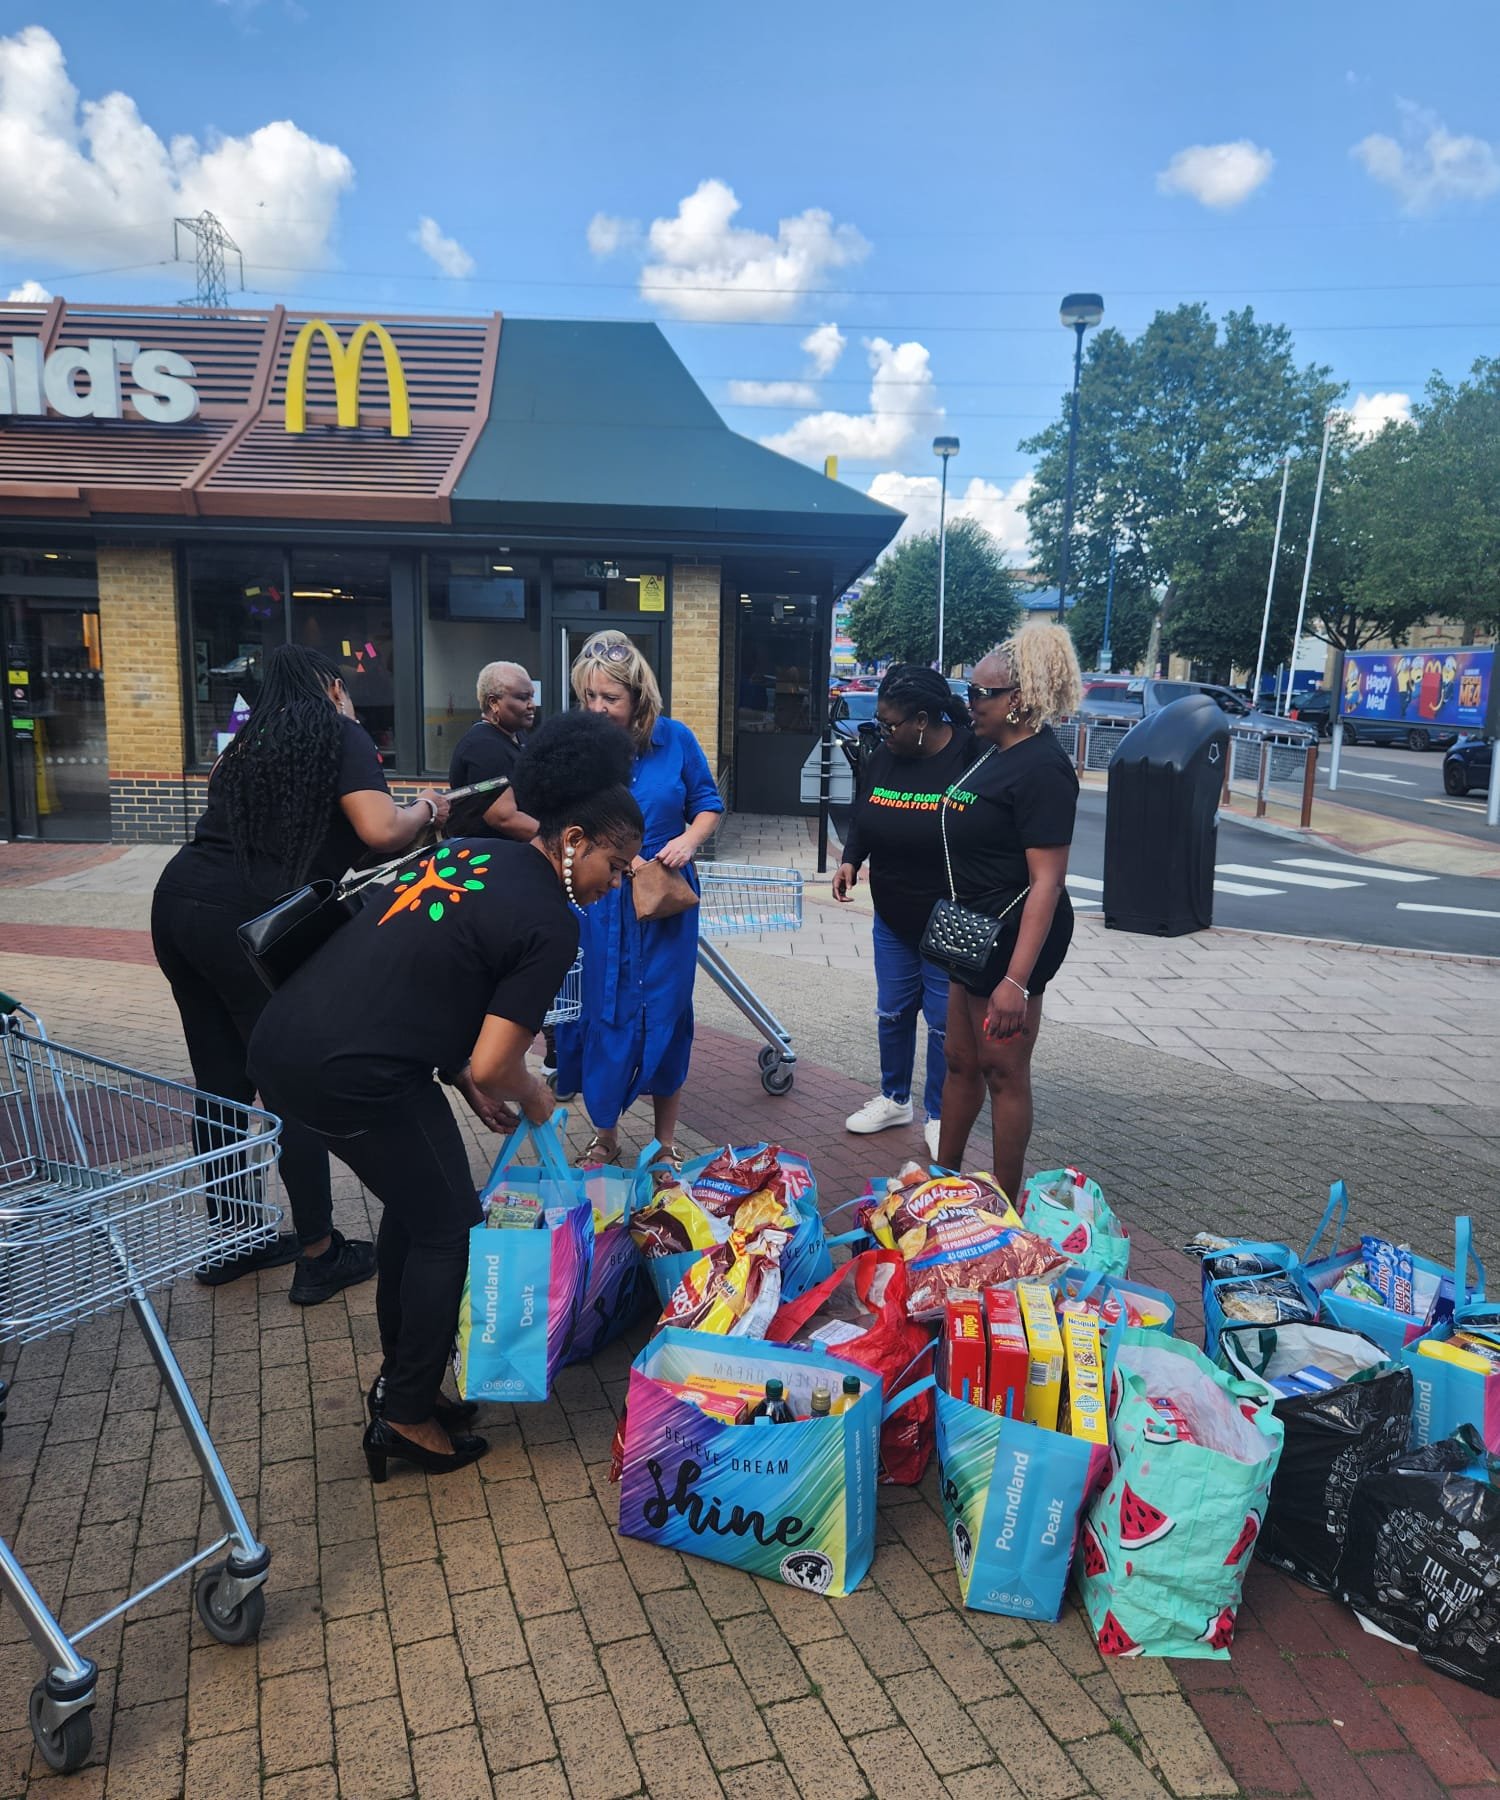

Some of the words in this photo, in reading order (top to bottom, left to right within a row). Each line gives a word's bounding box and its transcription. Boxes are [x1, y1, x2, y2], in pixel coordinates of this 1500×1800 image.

[0, 336, 201, 423] ld's
[1366, 673, 1392, 694] Happy
[1366, 694, 1388, 710] Meal
[868, 795, 939, 811] FOUNDATION
[873, 787, 901, 800] WOMEN
[901, 793, 914, 801] OF
[914, 793, 942, 803] GLORY
[947, 1207, 977, 1218] PACK
[950, 1237, 971, 1249] PRAWN
[956, 1246, 978, 1258] CHEESE
[482, 1255, 500, 1344] Poundland
[520, 1284, 535, 1328] Dealz
[1068, 1317, 1096, 1328] Nesquik
[1415, 1380, 1432, 1447] undland
[665, 1426, 720, 1466] BELIEVE
[731, 1457, 789, 1475] DREAM
[643, 1459, 815, 1548] Shine
[995, 1451, 1029, 1551] Poundland
[1041, 1498, 1064, 1546] Dealz
